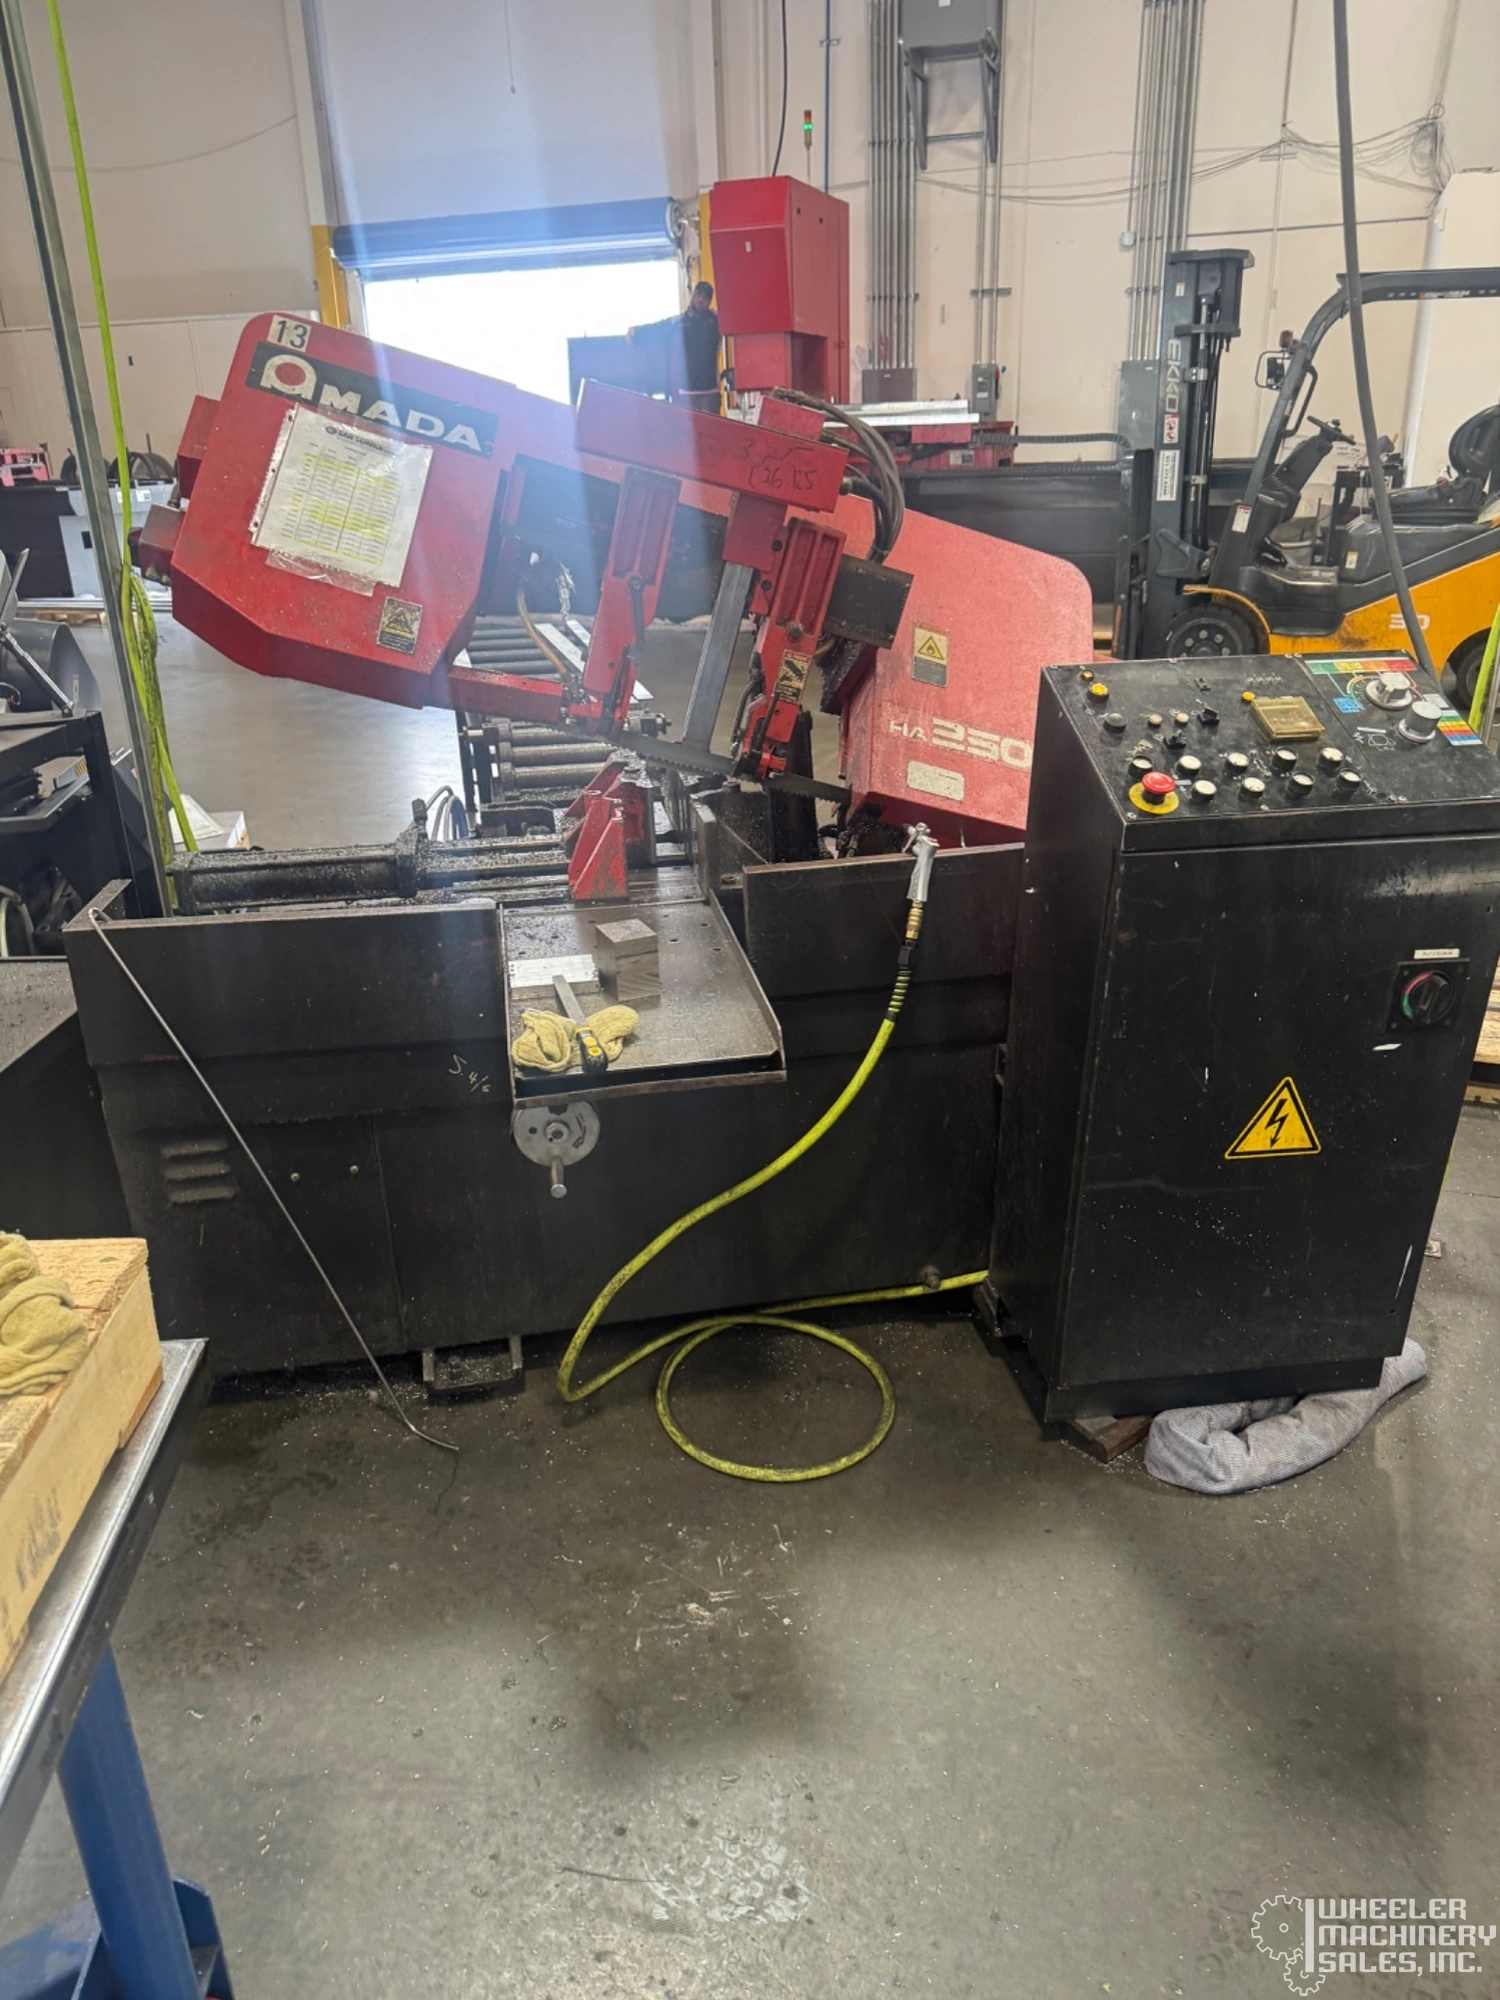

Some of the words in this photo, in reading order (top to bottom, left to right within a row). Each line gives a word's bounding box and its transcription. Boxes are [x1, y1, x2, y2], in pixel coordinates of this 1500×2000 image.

[276, 319, 309, 350] 13
[259, 353, 482, 452] AMADA
[1164, 338, 1182, 413] EKKO
